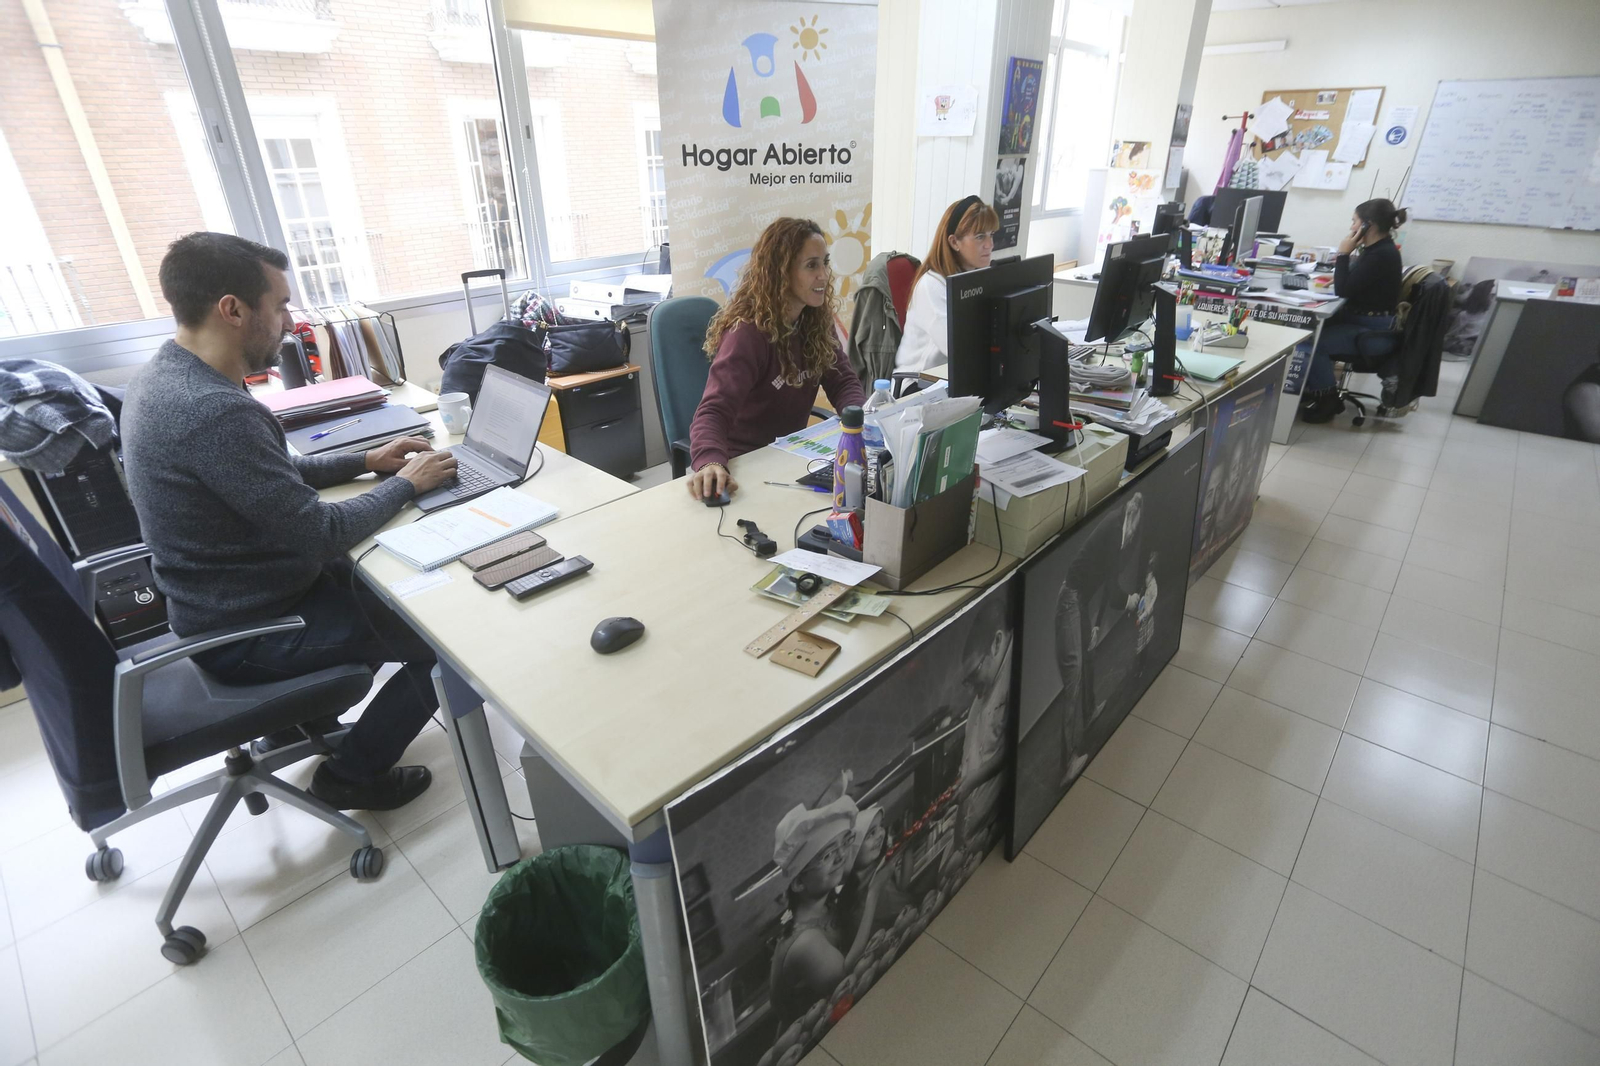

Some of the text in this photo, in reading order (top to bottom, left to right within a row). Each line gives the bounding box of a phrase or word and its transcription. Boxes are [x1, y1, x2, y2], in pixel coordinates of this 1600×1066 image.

[681, 143, 758, 172] Hogar
[762, 142, 852, 166] Abierto
[749, 172, 786, 187] Mejor
[789, 174, 806, 185] en
[809, 171, 852, 184] familia
[960, 286, 984, 300] Lenovo
[1197, 302, 1226, 314] ¿QUIERES
[1258, 310, 1268, 319] DE
[1268, 311, 1278, 320] SU
[1278, 312, 1312, 325] HISTORIA?
